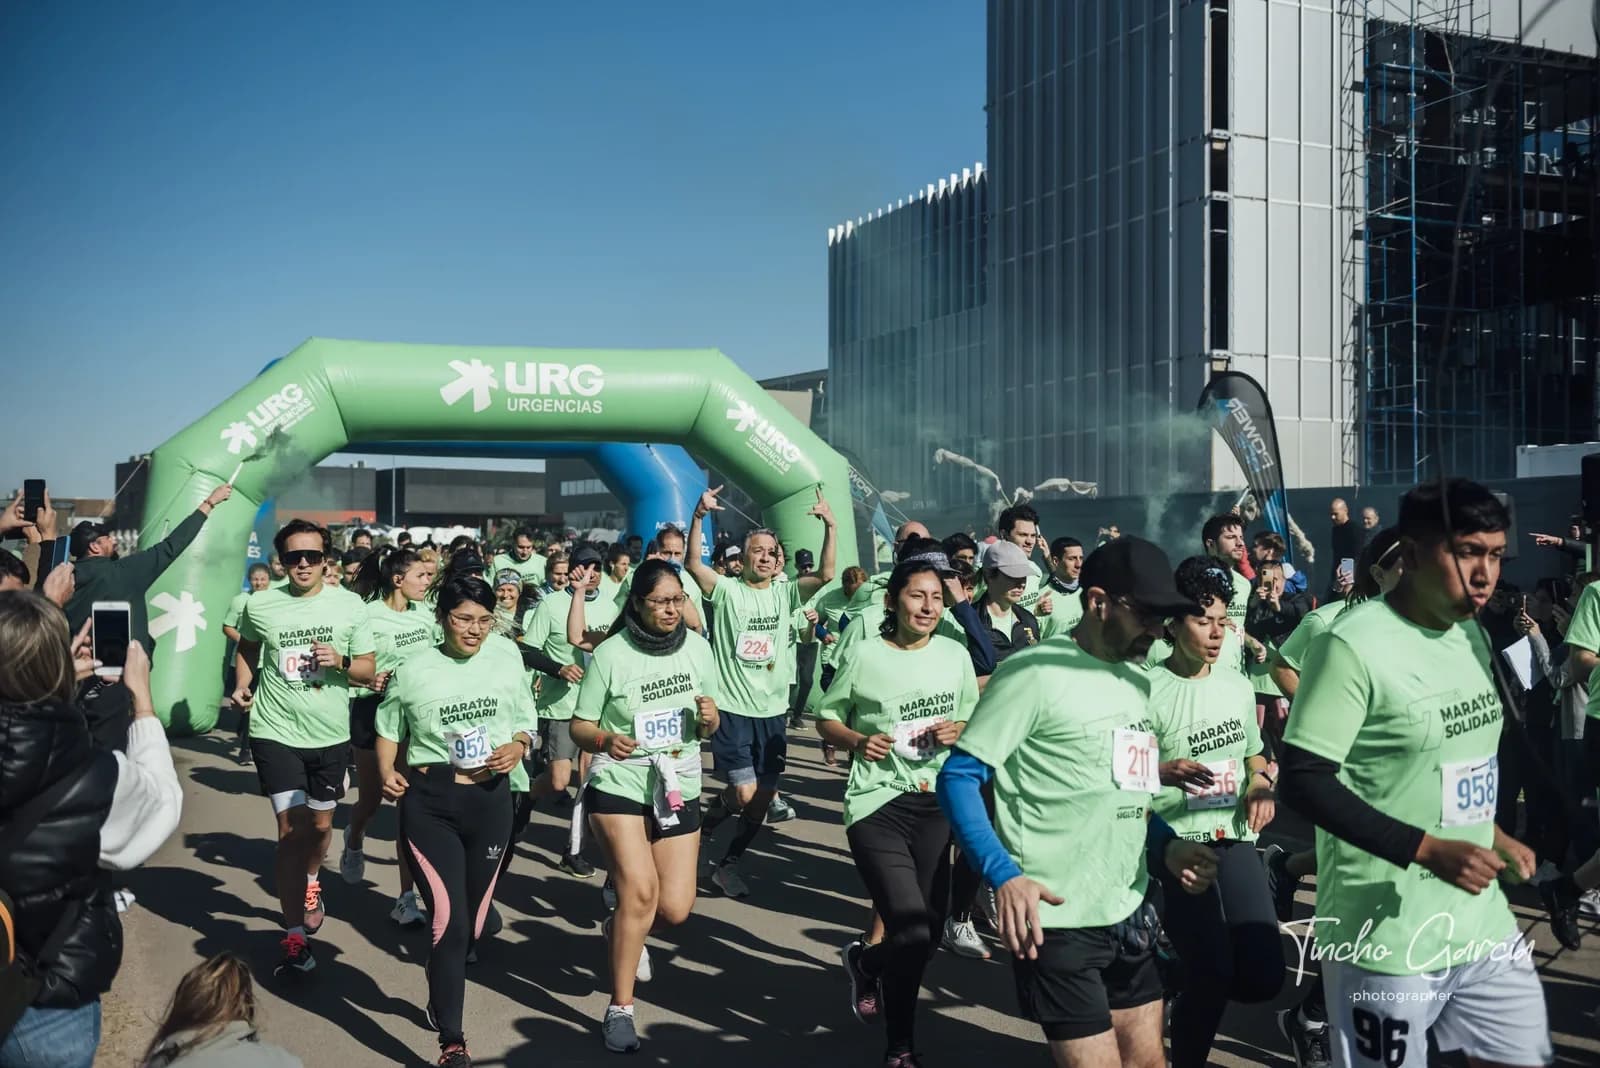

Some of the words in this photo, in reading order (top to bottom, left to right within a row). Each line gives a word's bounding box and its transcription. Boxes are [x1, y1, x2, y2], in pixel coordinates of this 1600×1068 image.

[505, 361, 605, 397] URG
[246, 383, 304, 428] URG
[507, 398, 603, 414] URGENCIAS
[755, 419, 801, 463] URG
[279, 625, 334, 640] MARATÓN
[743, 640, 769, 656] 224
[641, 672, 691, 694] MARATÓN
[642, 683, 694, 703] SOLIDARIA
[440, 696, 498, 717] MARATÓN
[900, 691, 955, 715] MARATÓN
[644, 718, 679, 740] 956
[1187, 717, 1243, 746] MARATÓN
[1445, 708, 1502, 739] SOLIDARI
[455, 735, 488, 760] 952
[1127, 744, 1150, 777] 211
[1199, 771, 1237, 798] 56
[1457, 771, 1496, 810] 958
[1352, 1007, 1409, 1068] 96
